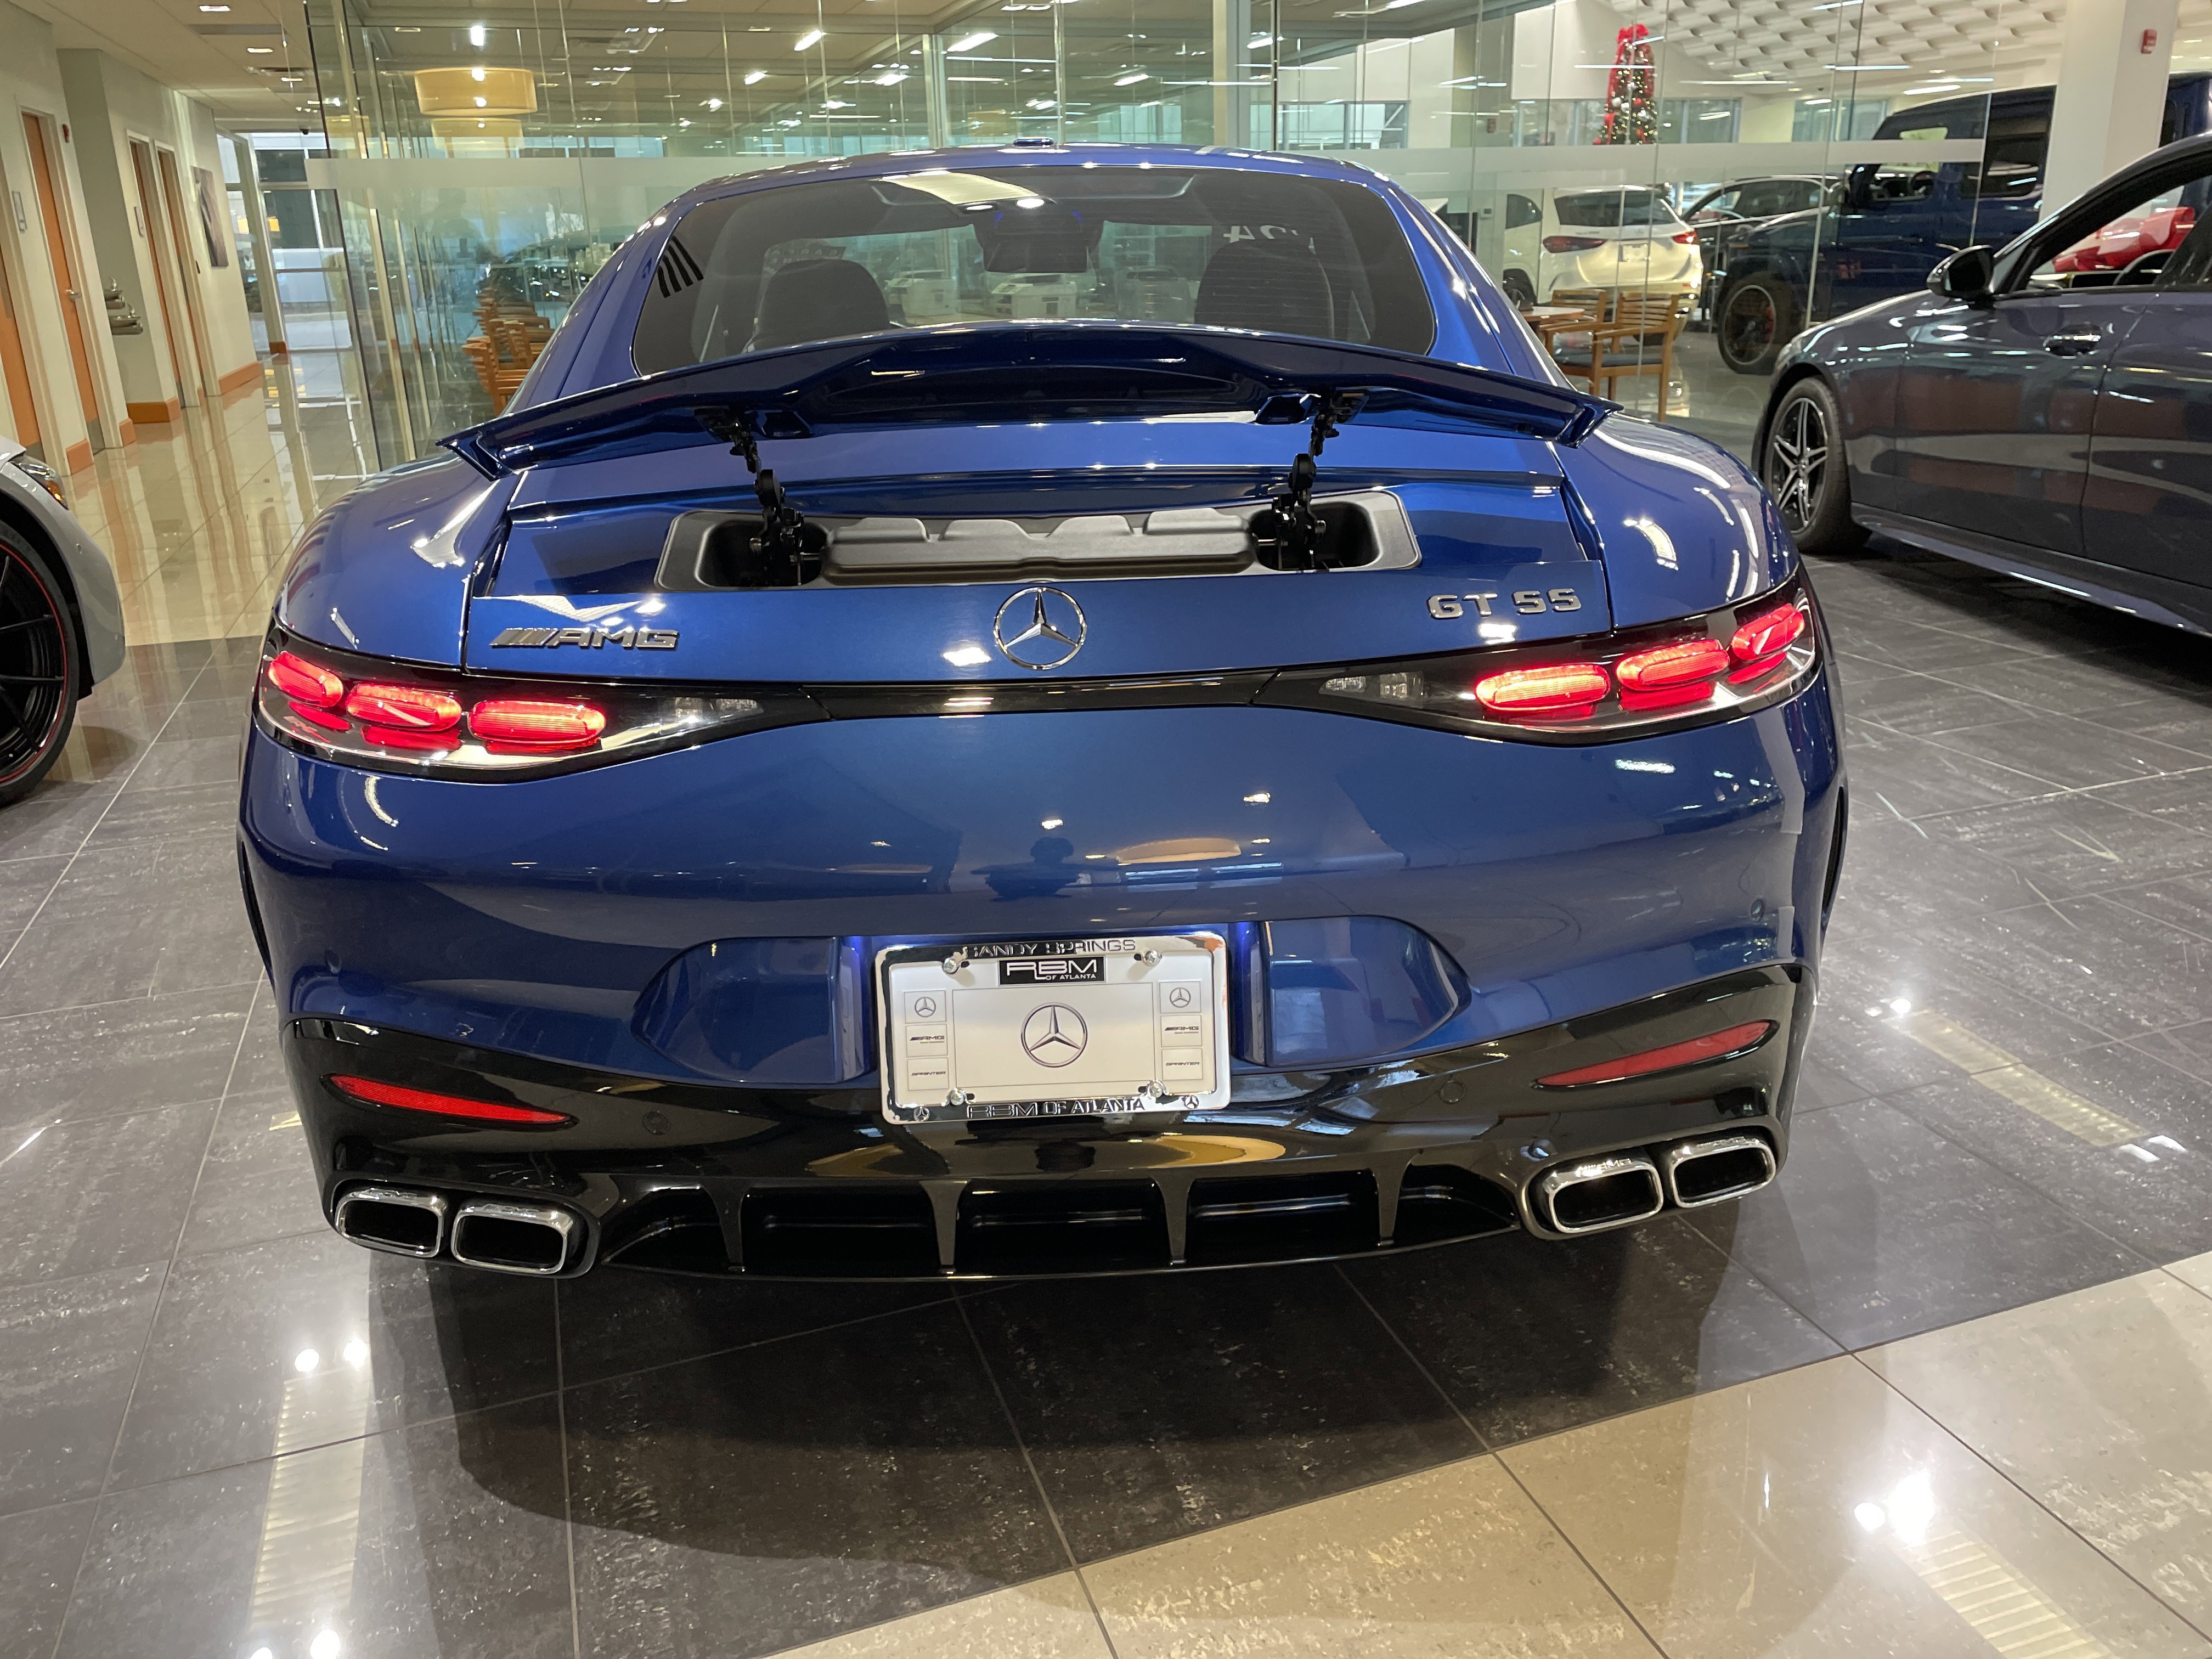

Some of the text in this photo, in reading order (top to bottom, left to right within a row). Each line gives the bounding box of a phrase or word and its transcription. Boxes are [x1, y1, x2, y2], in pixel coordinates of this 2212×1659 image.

[1427, 588, 1582, 618] GT 55
[1045, 939, 1136, 955] SPRINGS
[1006, 959, 1097, 980] RBM
[966, 1096, 1146, 1118] RBM OF ATLANTA
